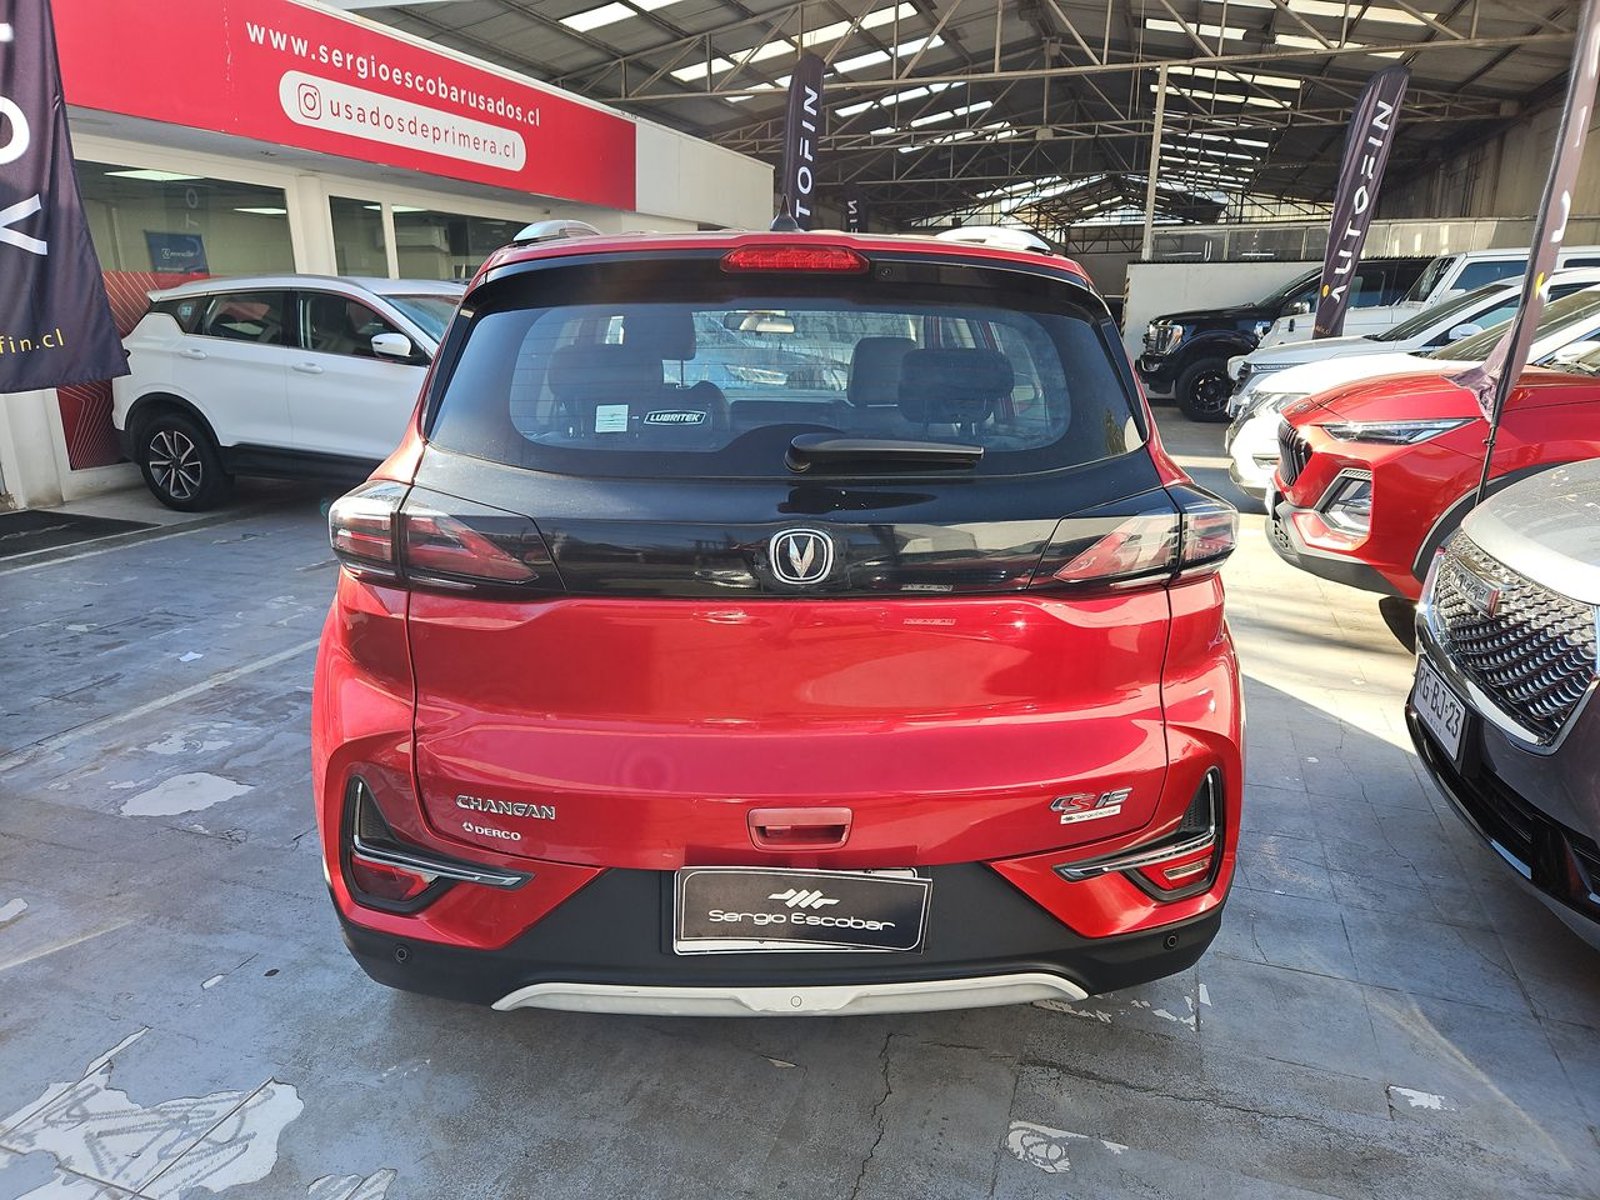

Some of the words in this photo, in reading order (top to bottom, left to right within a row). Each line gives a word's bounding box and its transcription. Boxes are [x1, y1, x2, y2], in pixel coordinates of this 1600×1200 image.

[246, 21, 541, 127] www.sergioescobarusados.cl
[329, 97, 517, 159] usadosdeprimera.cl
[1331, 100, 1393, 303] AUTOFIN
[649, 412, 701, 422] LUBRITEK
[456, 794, 556, 820] CHANGAN
[475, 825, 522, 841] DERCO
[708, 909, 787, 926] Sergio
[790, 912, 896, 931] Escobar
